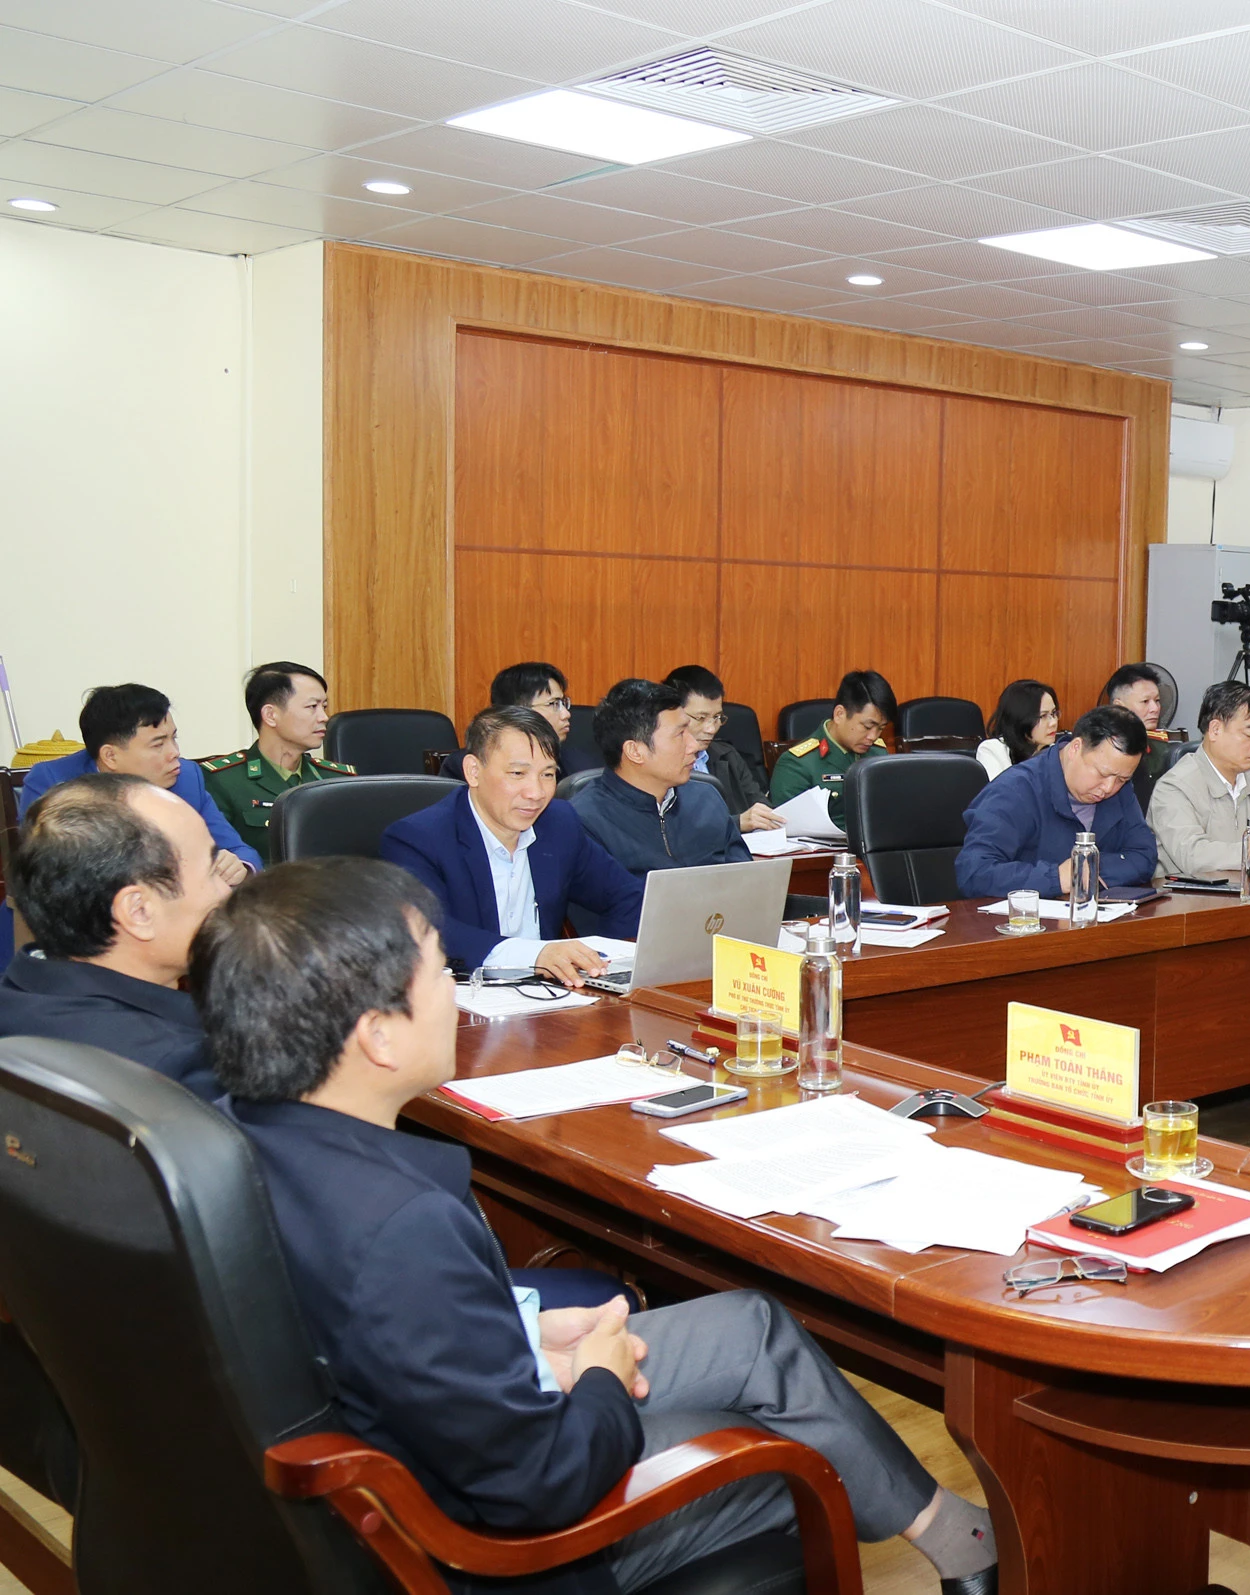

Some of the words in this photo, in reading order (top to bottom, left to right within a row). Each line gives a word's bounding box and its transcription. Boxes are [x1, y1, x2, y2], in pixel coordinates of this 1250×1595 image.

[1019, 1050, 1051, 1068] PHẠM
[1054, 1057, 1083, 1075] TOÀN
[1051, 1082, 1063, 1091] BAN
